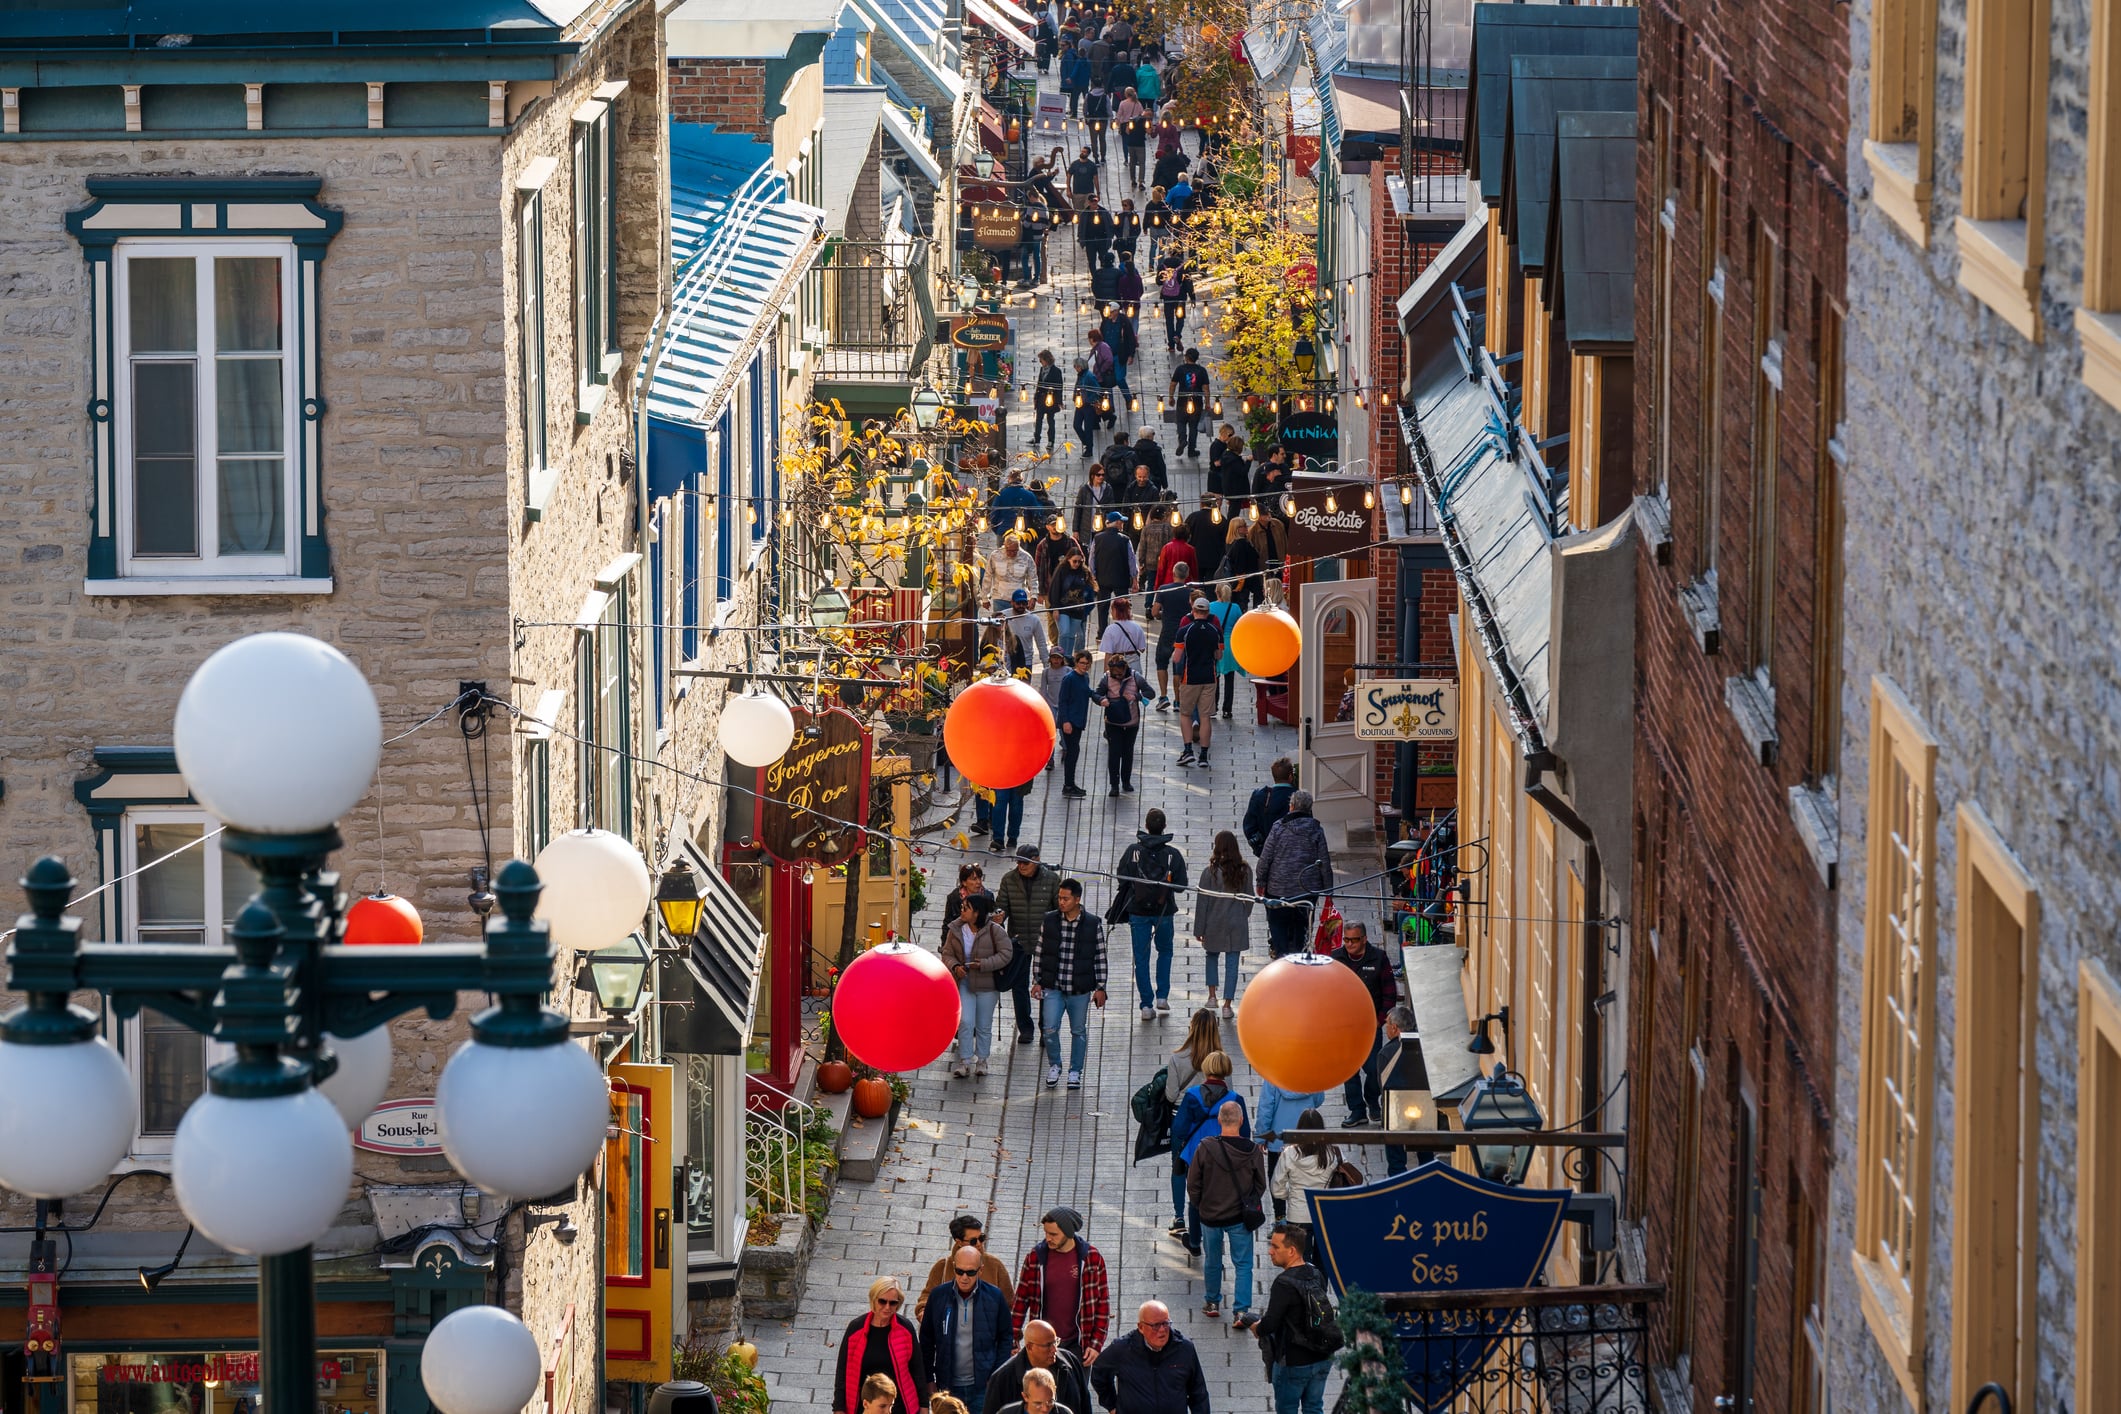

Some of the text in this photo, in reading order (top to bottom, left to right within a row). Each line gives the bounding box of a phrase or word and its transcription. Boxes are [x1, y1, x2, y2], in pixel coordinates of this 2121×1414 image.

[977, 226, 1018, 238] Flamand
[970, 333, 1002, 344] PERRIER
[979, 404, 996, 417] 0%
[1295, 507, 1366, 532] Chocolato
[791, 729, 818, 751] L
[1360, 728, 1454, 736] BOUTIQUE SOUVENIRS
[767, 739, 861, 793] Forgeron
[411, 1112, 428, 1120] Rue
[1383, 1210, 1488, 1247] Le pub
[1411, 1253, 1459, 1284] des
